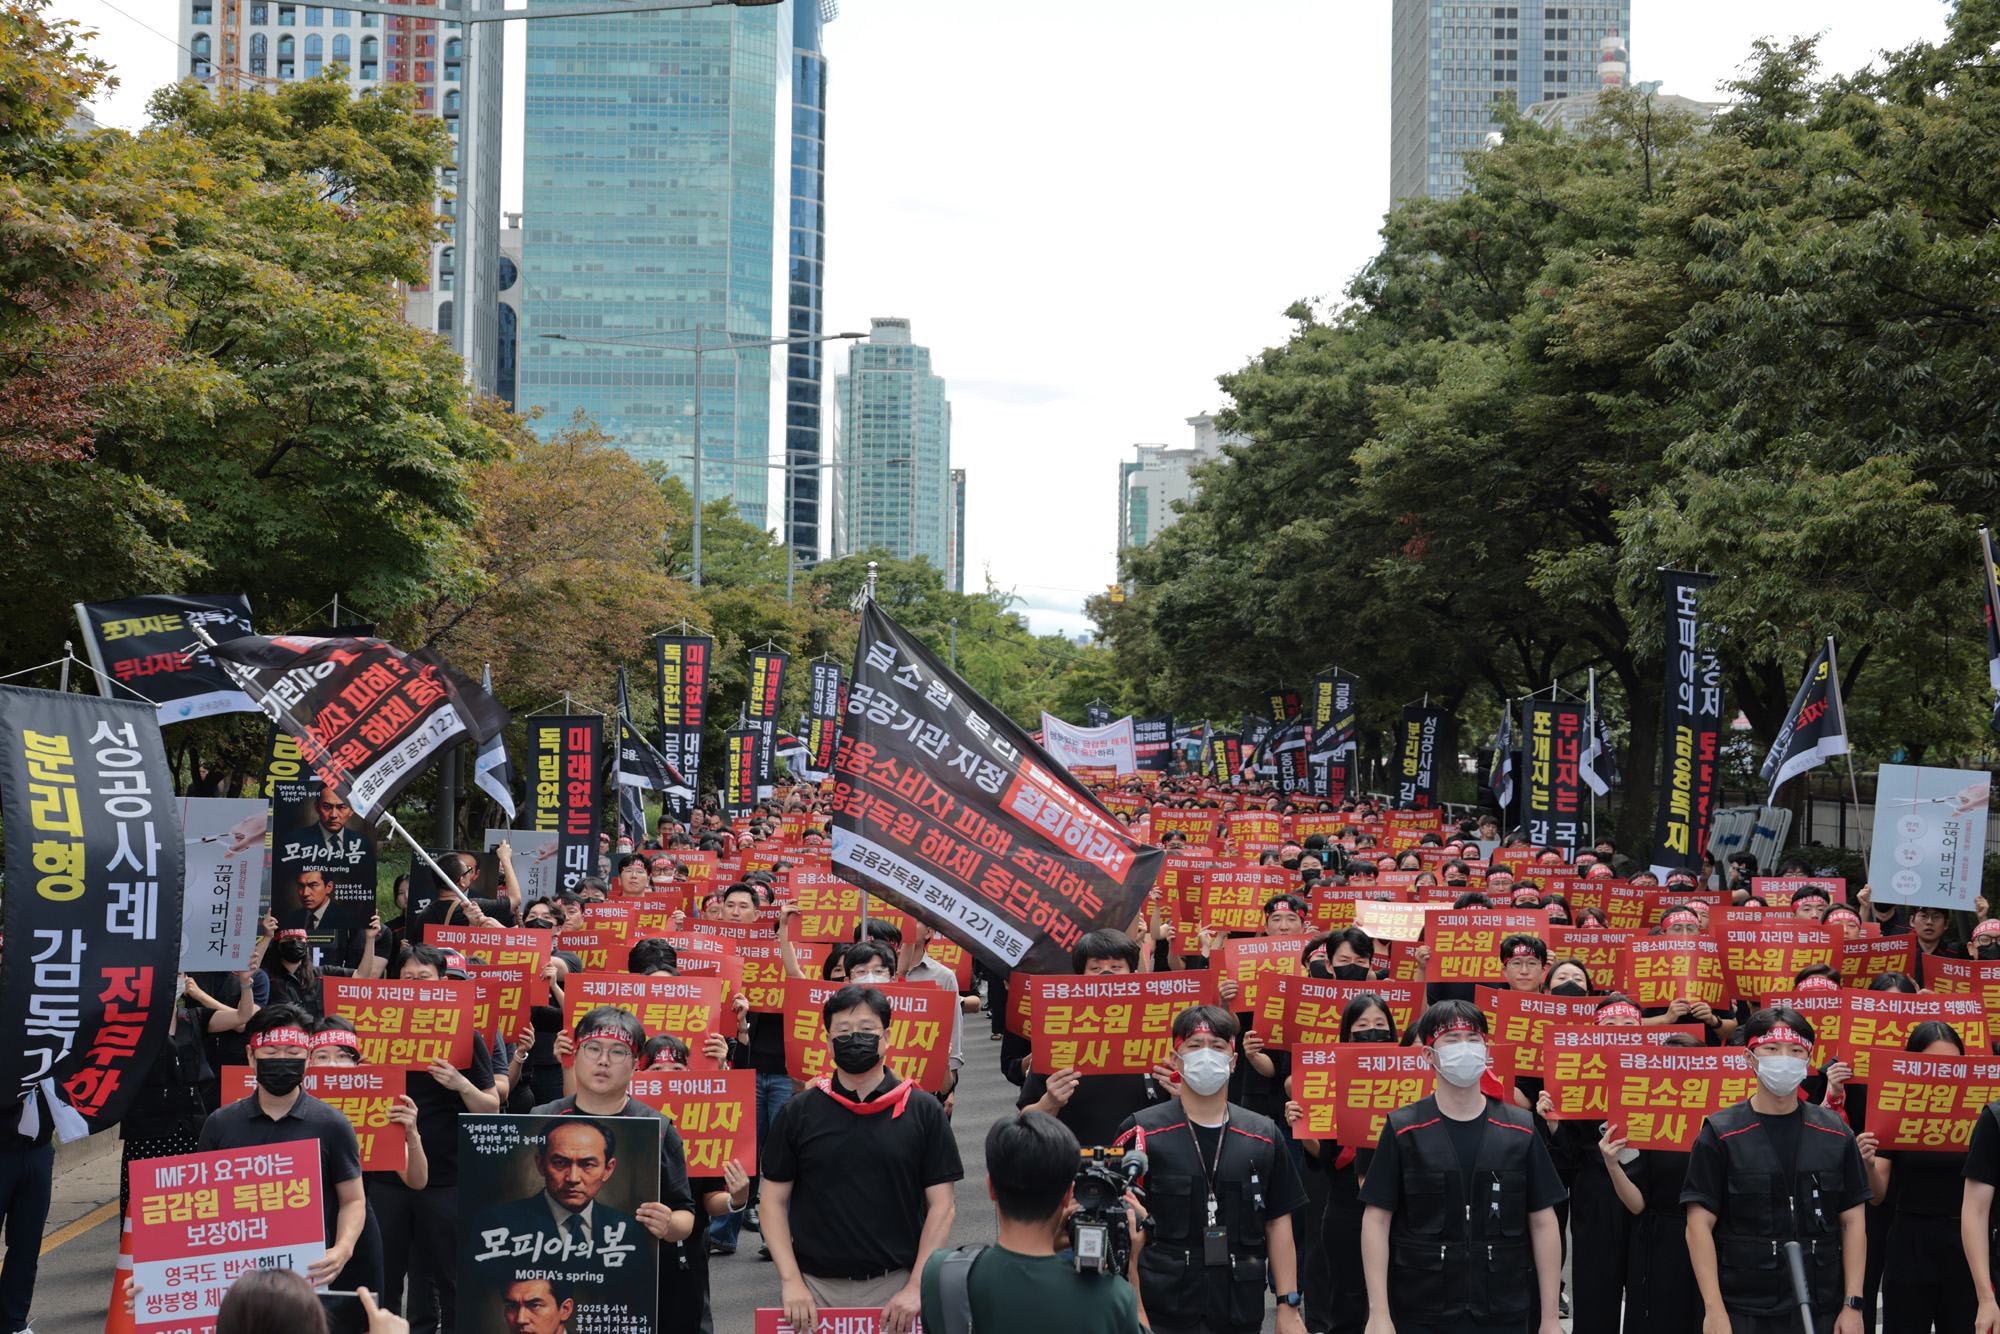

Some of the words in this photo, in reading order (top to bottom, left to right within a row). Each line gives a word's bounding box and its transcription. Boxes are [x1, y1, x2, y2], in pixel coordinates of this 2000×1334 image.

[101, 614, 184, 641] 쪼개지는
[1677, 585, 1697, 716] 모피아의
[339, 662, 398, 699] 피해
[663, 644, 682, 725] 독립없는
[685, 644, 705, 725] 미래없는
[749, 657, 767, 716] 독립없는
[764, 658, 782, 716] 미래없는
[864, 639, 954, 712] 금소원
[964, 707, 1019, 762] 분리
[358, 694, 416, 745] 해체
[404, 734, 431, 760] 공채
[847, 682, 950, 760] 공공기관
[947, 743, 1009, 794] 지정
[1403, 721, 1420, 777] 분리형
[1416, 716, 1437, 789] 성공사례
[1531, 711, 1552, 811] 쪼개지는
[1555, 713, 1579, 812] 무너지는
[535, 727, 561, 832] 독립없는
[567, 727, 593, 834] 미래없는
[23, 729, 85, 902] 분리형
[1009, 781, 1124, 872] 철회하라!
[88, 720, 162, 940] 성공사례
[1231, 822, 1263, 834] 금소원
[281, 842, 345, 863] 모피아의
[345, 838, 367, 865] 봄
[954, 802, 1016, 860] 피해
[1012, 847, 1104, 920] 초래하는
[1504, 851, 1528, 859] 관치금융
[1937, 820, 1960, 897] 끊어버리자
[302, 865, 328, 873] MOFIA's
[1211, 873, 1233, 883] 모피아
[1235, 873, 1262, 883] 자리만
[1527, 867, 1552, 875] 관치금융
[920, 826, 983, 879] 해체
[979, 865, 1085, 953] 중단하라!
[1207, 886, 1255, 906] 금소원
[1323, 891, 1363, 900] 국제기준에
[1429, 889, 1450, 898] 모피아
[1572, 882, 1593, 891] 모피아
[1611, 887, 1634, 897] 모피아
[207, 865, 234, 957] 끊어버리자
[848, 842, 925, 893] 금융감독원
[924, 876, 958, 912] 공채
[958, 902, 996, 938] 12기
[996, 929, 1024, 958] 일동
[595, 908, 629, 919] 역행하는
[1438, 915, 1469, 926] 모피아
[1472, 915, 1503, 926] 자리만
[1505, 915, 1536, 926] 늘리는
[1726, 911, 1763, 922] 관치금융
[719, 924, 747, 937] 자리만
[749, 928, 776, 940] 늘리는
[801, 915, 844, 937] 결사
[1727, 931, 1757, 943] 모피아
[1760, 932, 1794, 943] 자리만
[1797, 931, 1831, 943] 늘리는
[436, 931, 467, 943] 모피아
[470, 931, 501, 945] 자리만
[504, 933, 538, 947] 늘리는
[562, 936, 599, 947] 막아내고
[692, 939, 724, 953] 늘리는
[1238, 943, 1269, 955] 모피아
[1271, 941, 1302, 953] 자리만
[1435, 930, 1495, 952] 금소원
[1564, 933, 1599, 944] 관치금융
[1632, 941, 1697, 952] 금융소비자보호
[1871, 940, 1909, 953] 역행하는
[1634, 955, 1691, 979] 금소원
[1727, 948, 1784, 971] 금소원
[1790, 948, 1833, 972] 분리
[1867, 954, 1907, 973] 분리
[338, 985, 373, 1000] 모피아
[377, 985, 415, 1001] 자리만
[419, 988, 458, 1002] 늘리는
[582, 981, 647, 996] 국제기준에
[650, 983, 702, 999] 부합하는
[1042, 981, 1141, 999] 금융소비자보호
[1145, 978, 1201, 996] 역행하는
[1301, 984, 1338, 1000] 모피아
[1380, 987, 1412, 1002] 늘리는
[1638, 980, 1677, 1002] 결사
[1684, 980, 1723, 1003] 반대!
[642, 1002, 711, 1032] 독립성
[1520, 999, 1567, 1016] 관치금융
[1851, 996, 1941, 1015] 금융소비자보호
[1944, 1000, 1983, 1015] 역행하는
[410, 1006, 462, 1035] 분리
[1043, 1003, 1133, 1035] 금소원
[61, 966, 153, 1117] 전무한
[1554, 1032, 1643, 1047] 금융소비자보호
[1050, 1040, 1111, 1070] 결사
[1357, 1056, 1431, 1072] 국제기준에
[1619, 1053, 1719, 1071] 금융소비자보호
[1892, 1059, 1967, 1079] 국제기준에
[323, 1073, 384, 1091] 부합하는
[668, 1078, 727, 1095] 막아내고
[1347, 1078, 1424, 1109] 금감원
[1620, 1076, 1710, 1109] 금소원
[1877, 1080, 1958, 1113] 금감원
[462, 1123, 498, 1134] "실패하면
[470, 1134, 502, 1145] 성공하면
[504, 1135, 521, 1145] 자리
[522, 1135, 547, 1145] 늘리기
[1626, 1112, 1688, 1144] 결사
[155, 1162, 209, 1189] IMF가
[214, 1153, 294, 1181] 요구하는
[142, 1188, 220, 1225] 금감원
[233, 1177, 312, 1213] 독립성
[187, 1217, 268, 1247] 보장하라
[474, 1227, 595, 1263] 모피아의
[596, 1221, 636, 1267] 봄
[165, 1263, 218, 1287] 영국도
[515, 1269, 564, 1281] MOFIA's
[566, 1271, 604, 1284] spring
[145, 1290, 199, 1315] 쌍봉형
